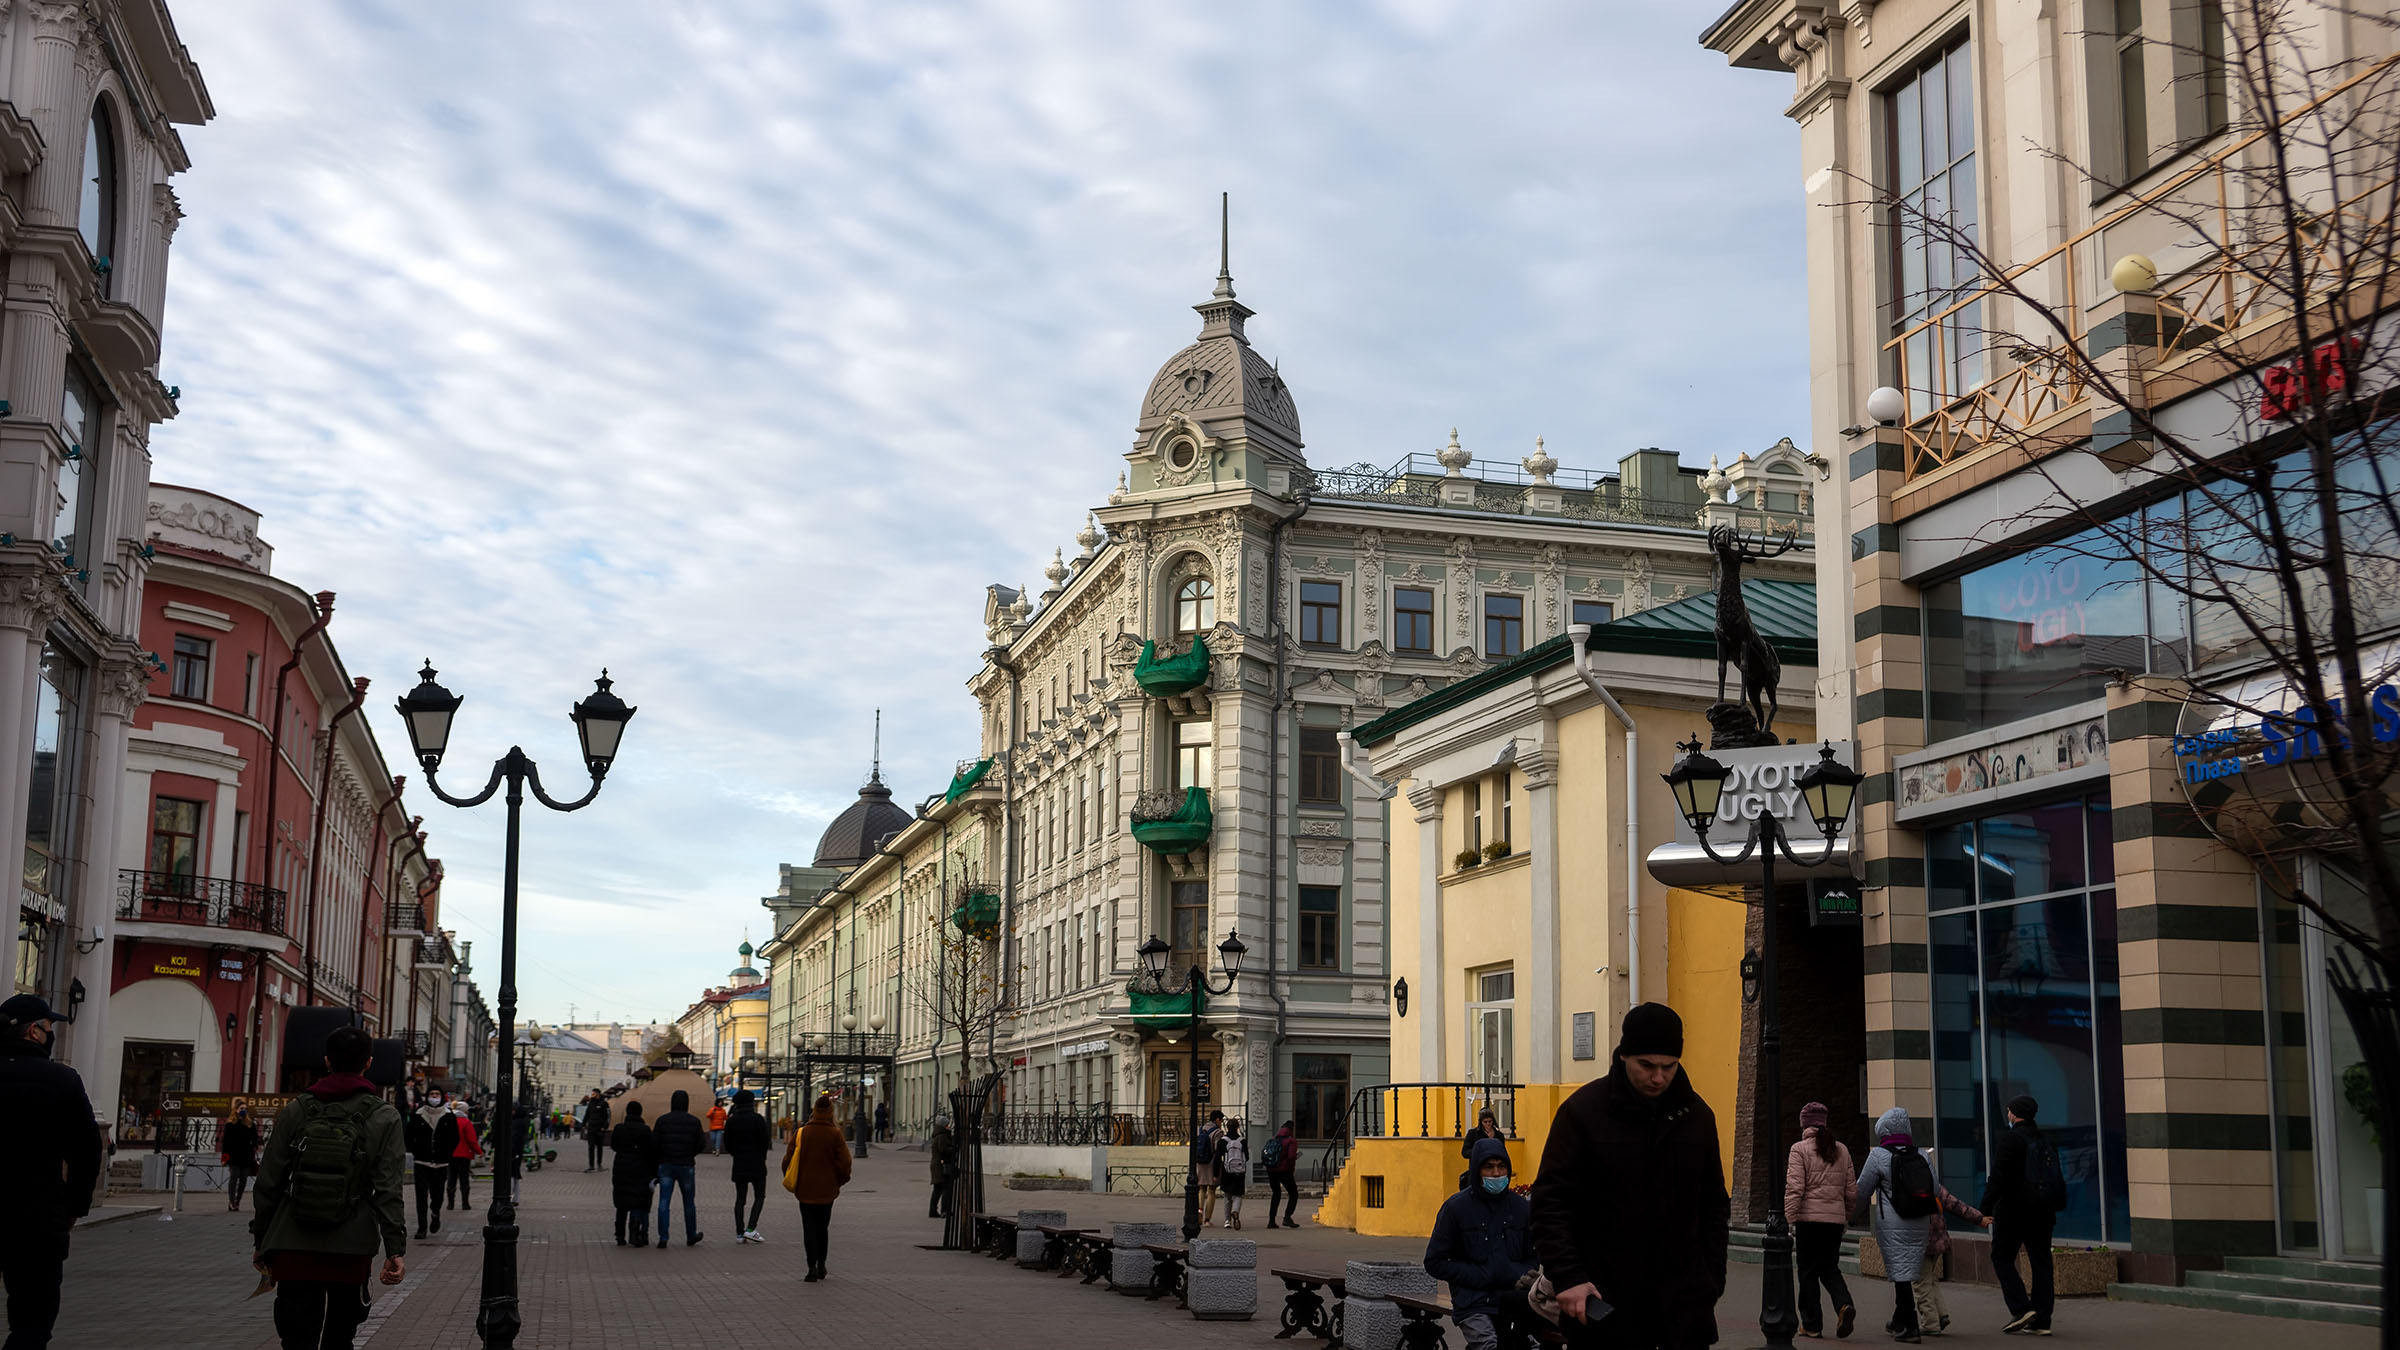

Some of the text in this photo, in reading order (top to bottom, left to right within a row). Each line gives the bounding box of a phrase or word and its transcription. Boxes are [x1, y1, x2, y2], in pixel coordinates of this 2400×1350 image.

[2174, 727, 2240, 757] Сервис
[2186, 756, 2240, 785] Плаза
[1718, 790, 1801, 822] UGLY
[154, 964, 200, 977] Казанский
[171, 956, 187, 966] КОТ
[248, 1098, 295, 1106] ВЫСТ
